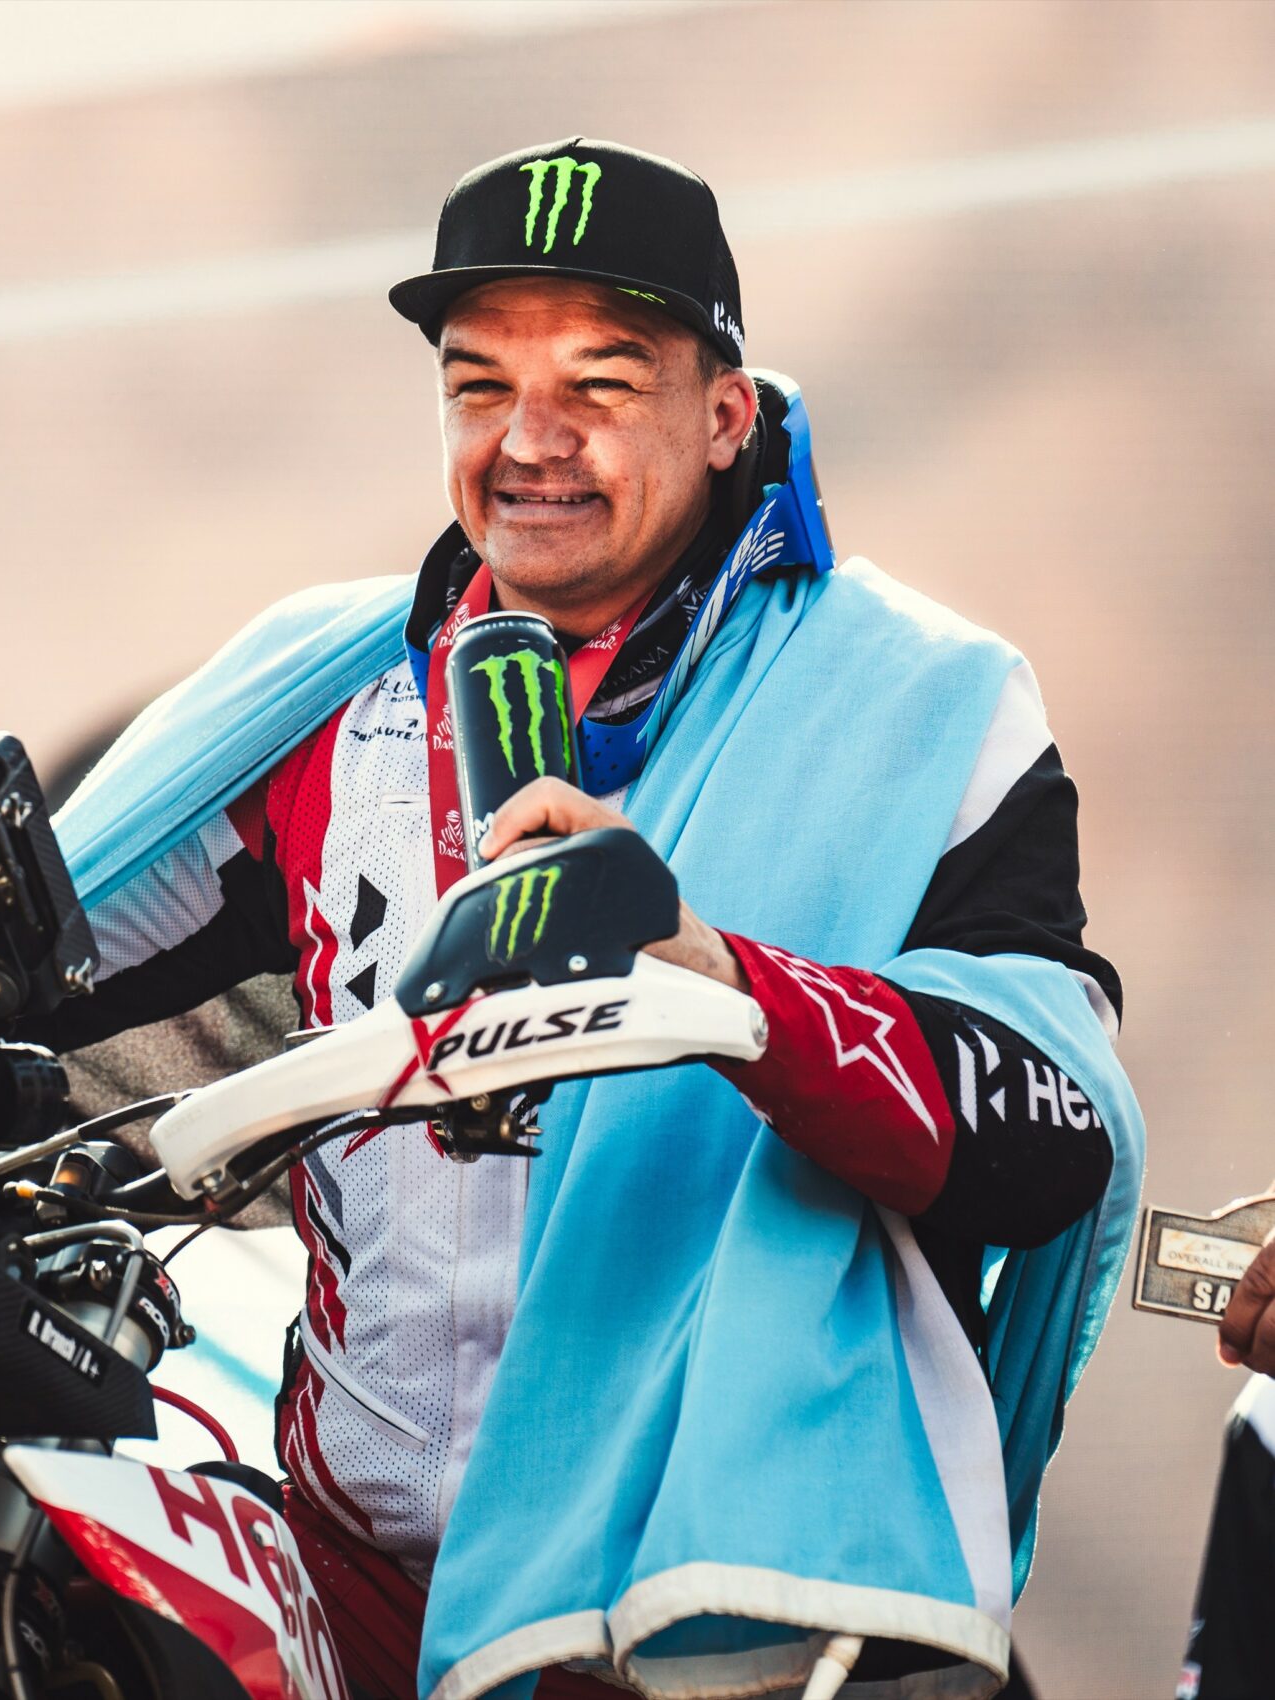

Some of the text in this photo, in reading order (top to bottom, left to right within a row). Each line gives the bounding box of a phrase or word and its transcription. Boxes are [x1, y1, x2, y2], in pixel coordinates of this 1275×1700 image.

[434, 734, 456, 751] DAK
[437, 839, 467, 862] DAKA
[1193, 1280, 1232, 1313] SA
